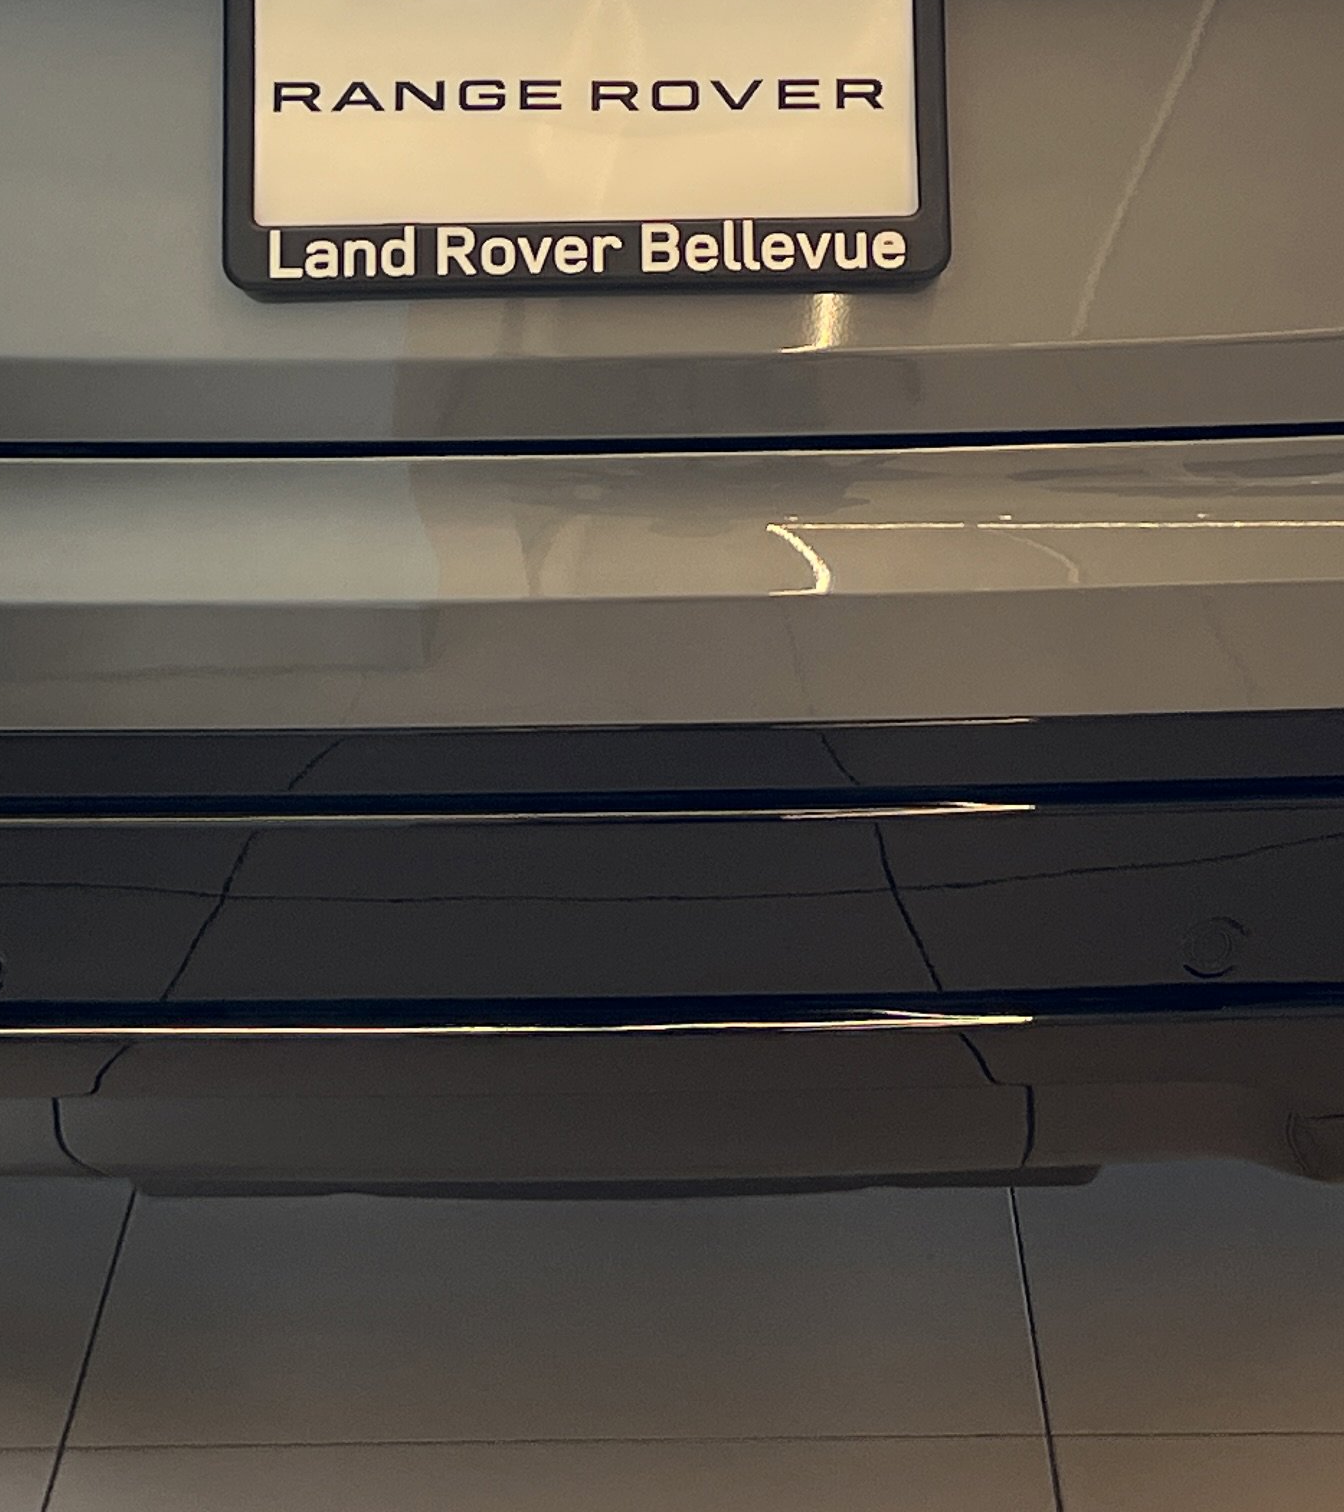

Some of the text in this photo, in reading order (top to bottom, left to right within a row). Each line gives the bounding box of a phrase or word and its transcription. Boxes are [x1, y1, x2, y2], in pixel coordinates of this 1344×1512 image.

[272, 78, 885, 113] RANGE ROVER
[267, 219, 908, 280] Land Rover Bellevue
